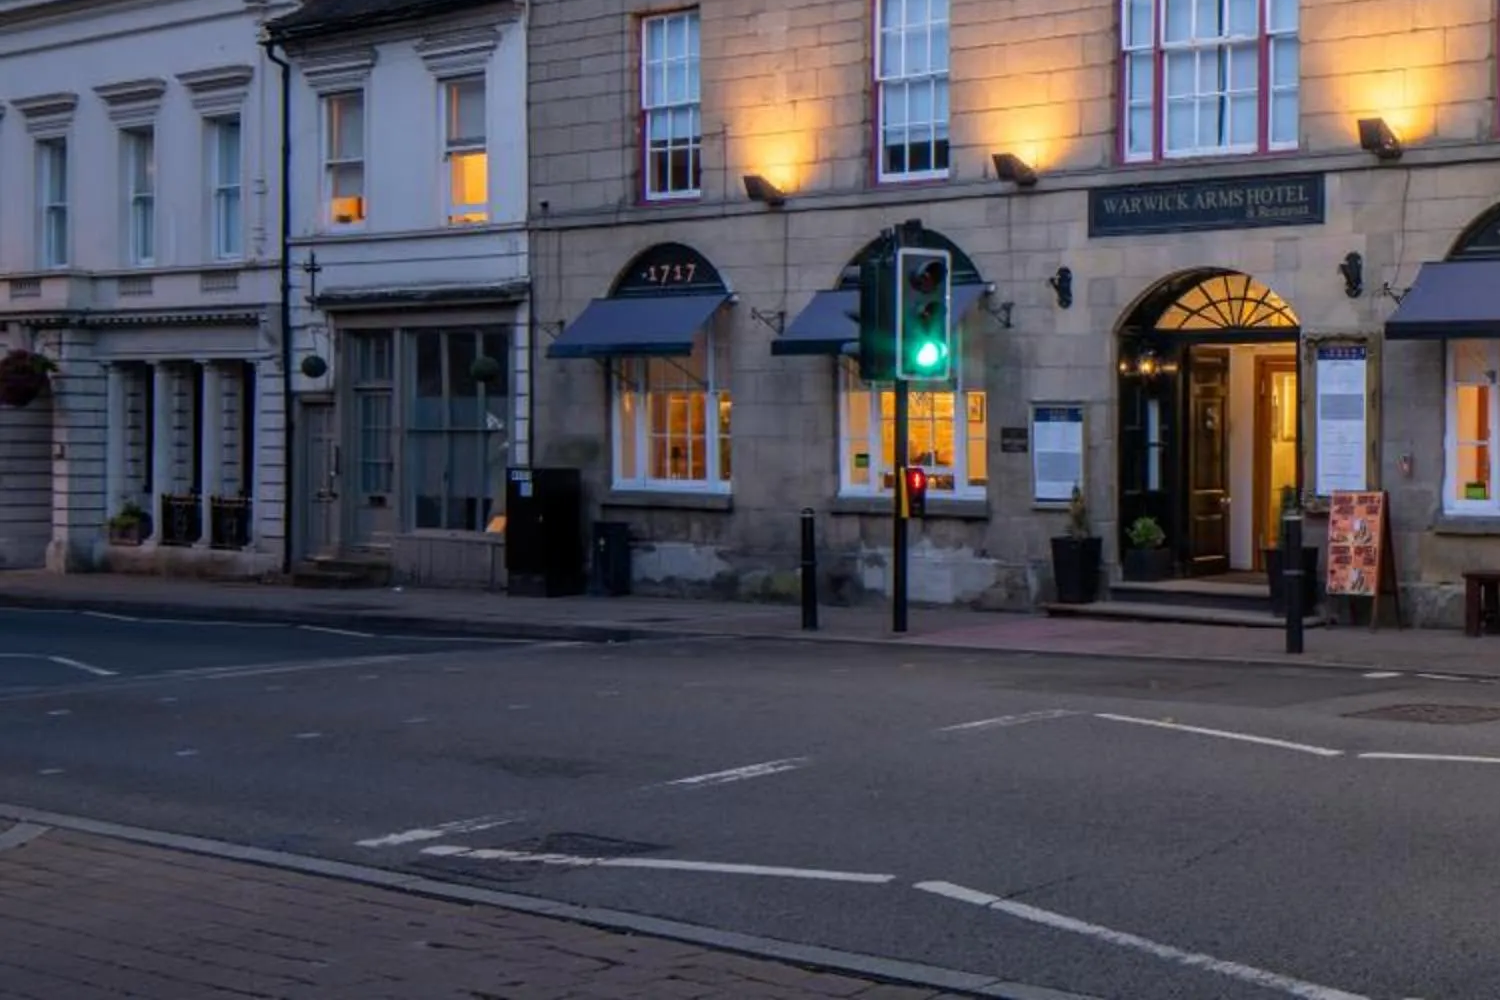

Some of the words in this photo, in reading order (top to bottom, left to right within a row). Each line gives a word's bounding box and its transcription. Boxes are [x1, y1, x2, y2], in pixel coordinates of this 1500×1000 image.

[1103, 193, 1189, 215] WARWICK
[1192, 188, 1244, 210] ARMS
[1246, 185, 1310, 205] HOTEL
[648, 263, 696, 286] 1717
